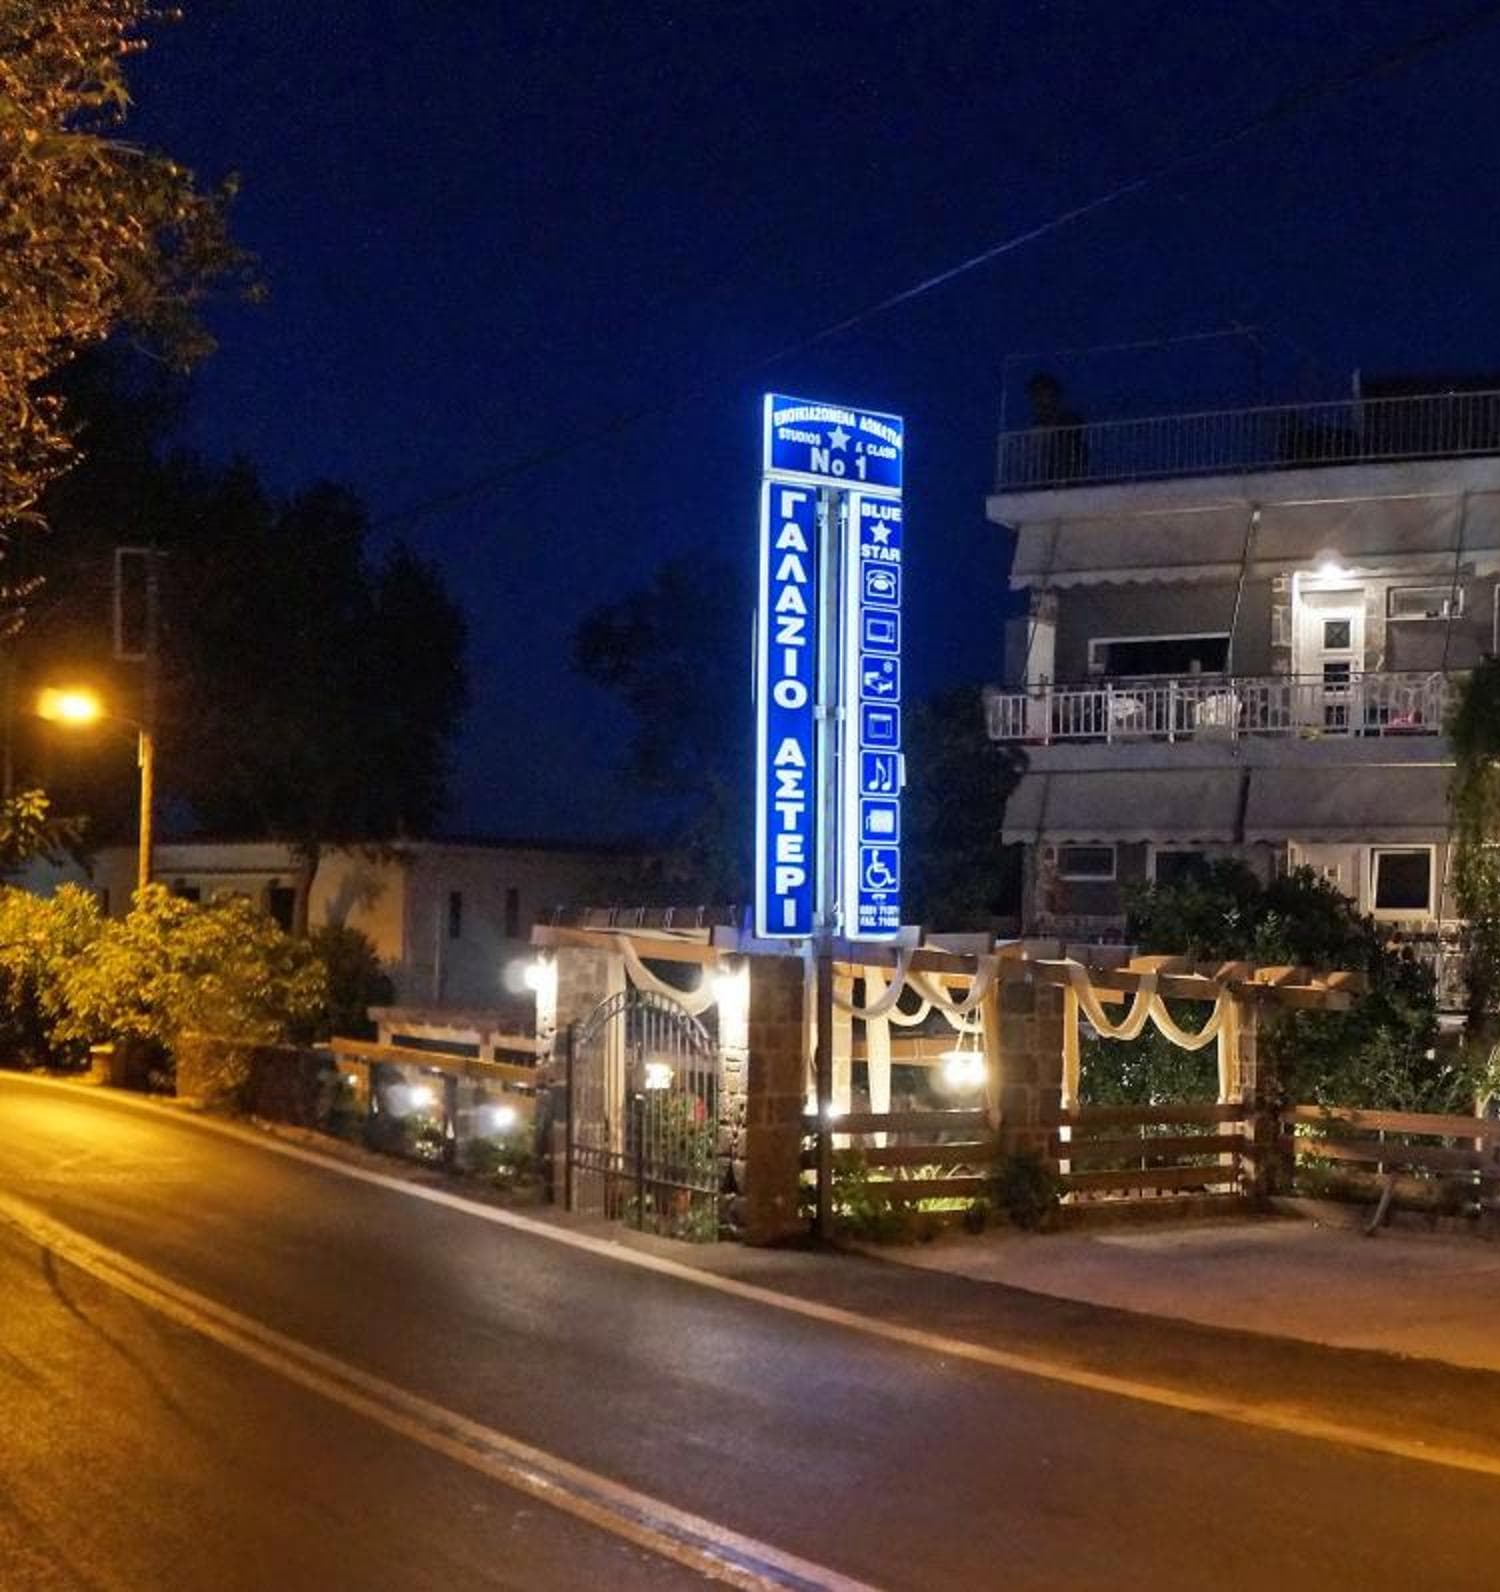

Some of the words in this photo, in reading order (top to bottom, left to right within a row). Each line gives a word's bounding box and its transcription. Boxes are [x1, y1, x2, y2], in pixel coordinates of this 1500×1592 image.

[778, 427, 821, 446] STUDIOS
[866, 443, 897, 460] CLASS
[811, 447, 845, 476] No
[855, 455, 867, 480] 1
[861, 502, 901, 522] BLUE
[861, 543, 900, 562] STAR
[773, 490, 808, 709] ΓΑΛΑΖΙΟ
[773, 737, 807, 927] ΑΣΤΕΡΙ
